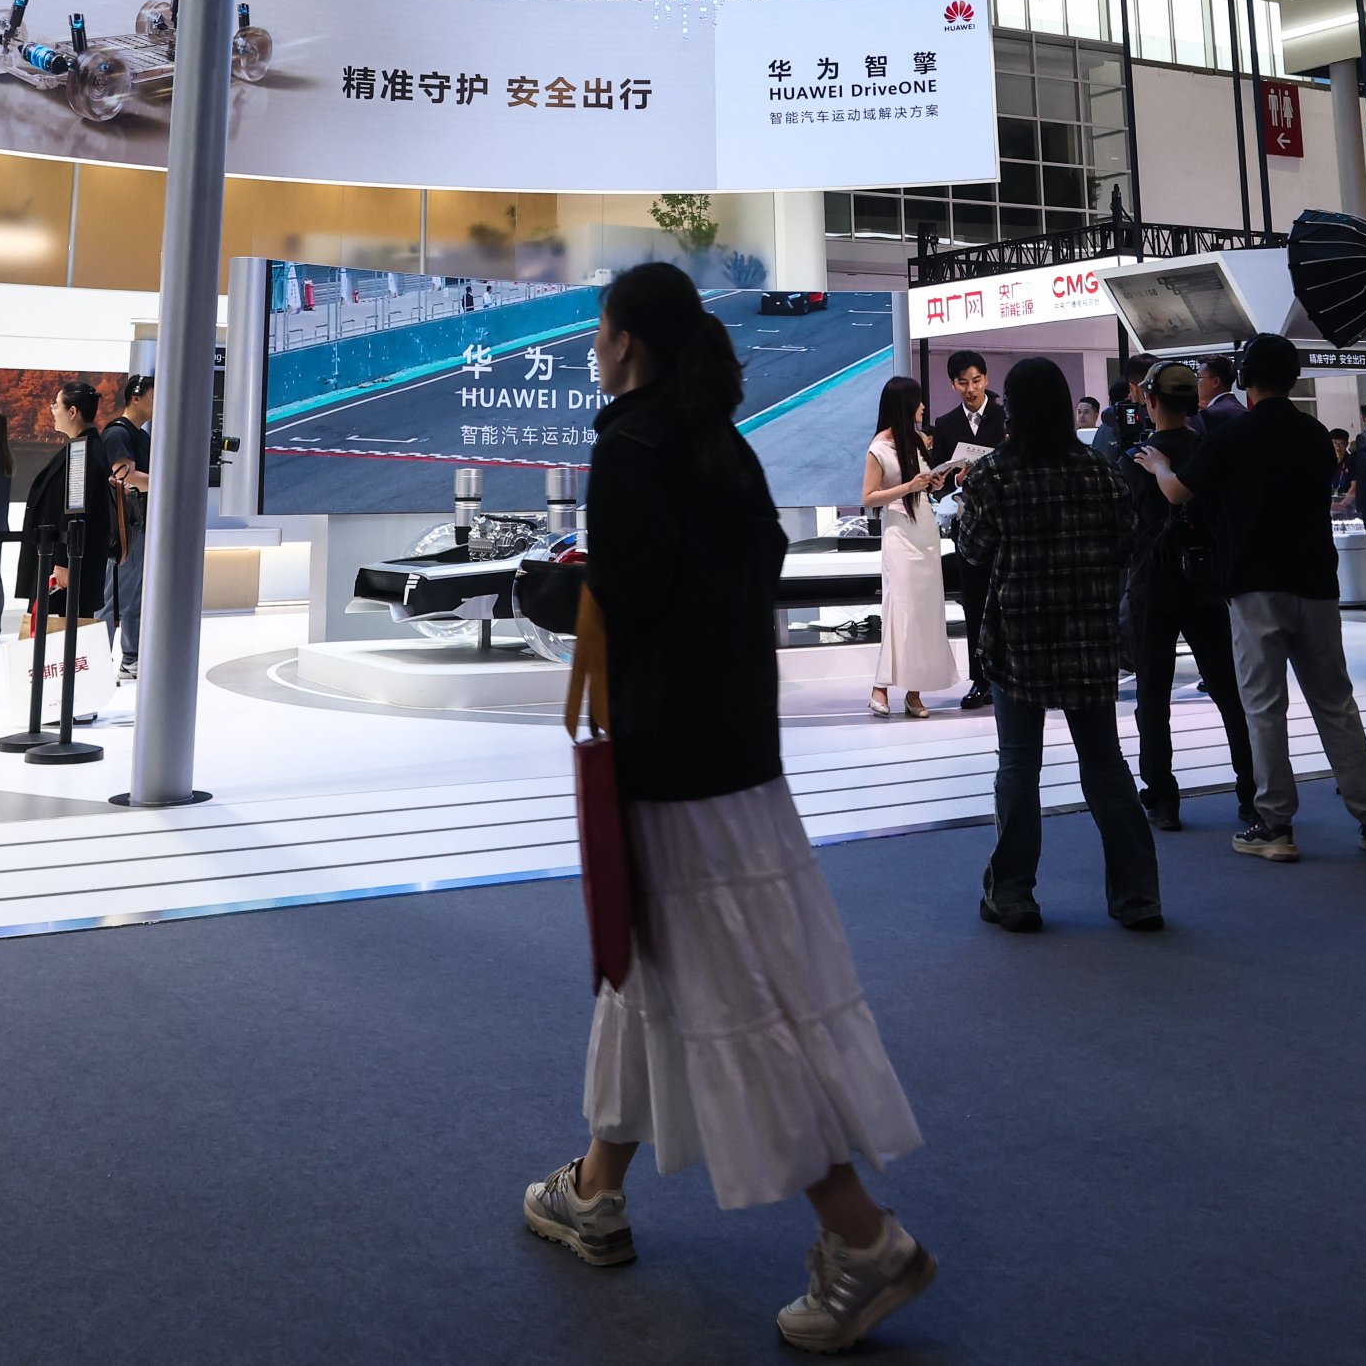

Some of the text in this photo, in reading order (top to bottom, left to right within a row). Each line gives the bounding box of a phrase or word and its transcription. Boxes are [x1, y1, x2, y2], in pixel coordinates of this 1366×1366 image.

[944, 24, 976, 32] HUAWEI
[768, 51, 938, 82] 华为智擎
[342, 65, 653, 110] 精准守护 安全出行
[769, 79, 938, 101] HUAWEI DriveONE
[769, 103, 939, 125] 智能汽车运动域解决方案
[1052, 271, 1099, 298] CMG
[999, 298, 1035, 319] 新能源
[461, 387, 557, 409] HUAWEI
